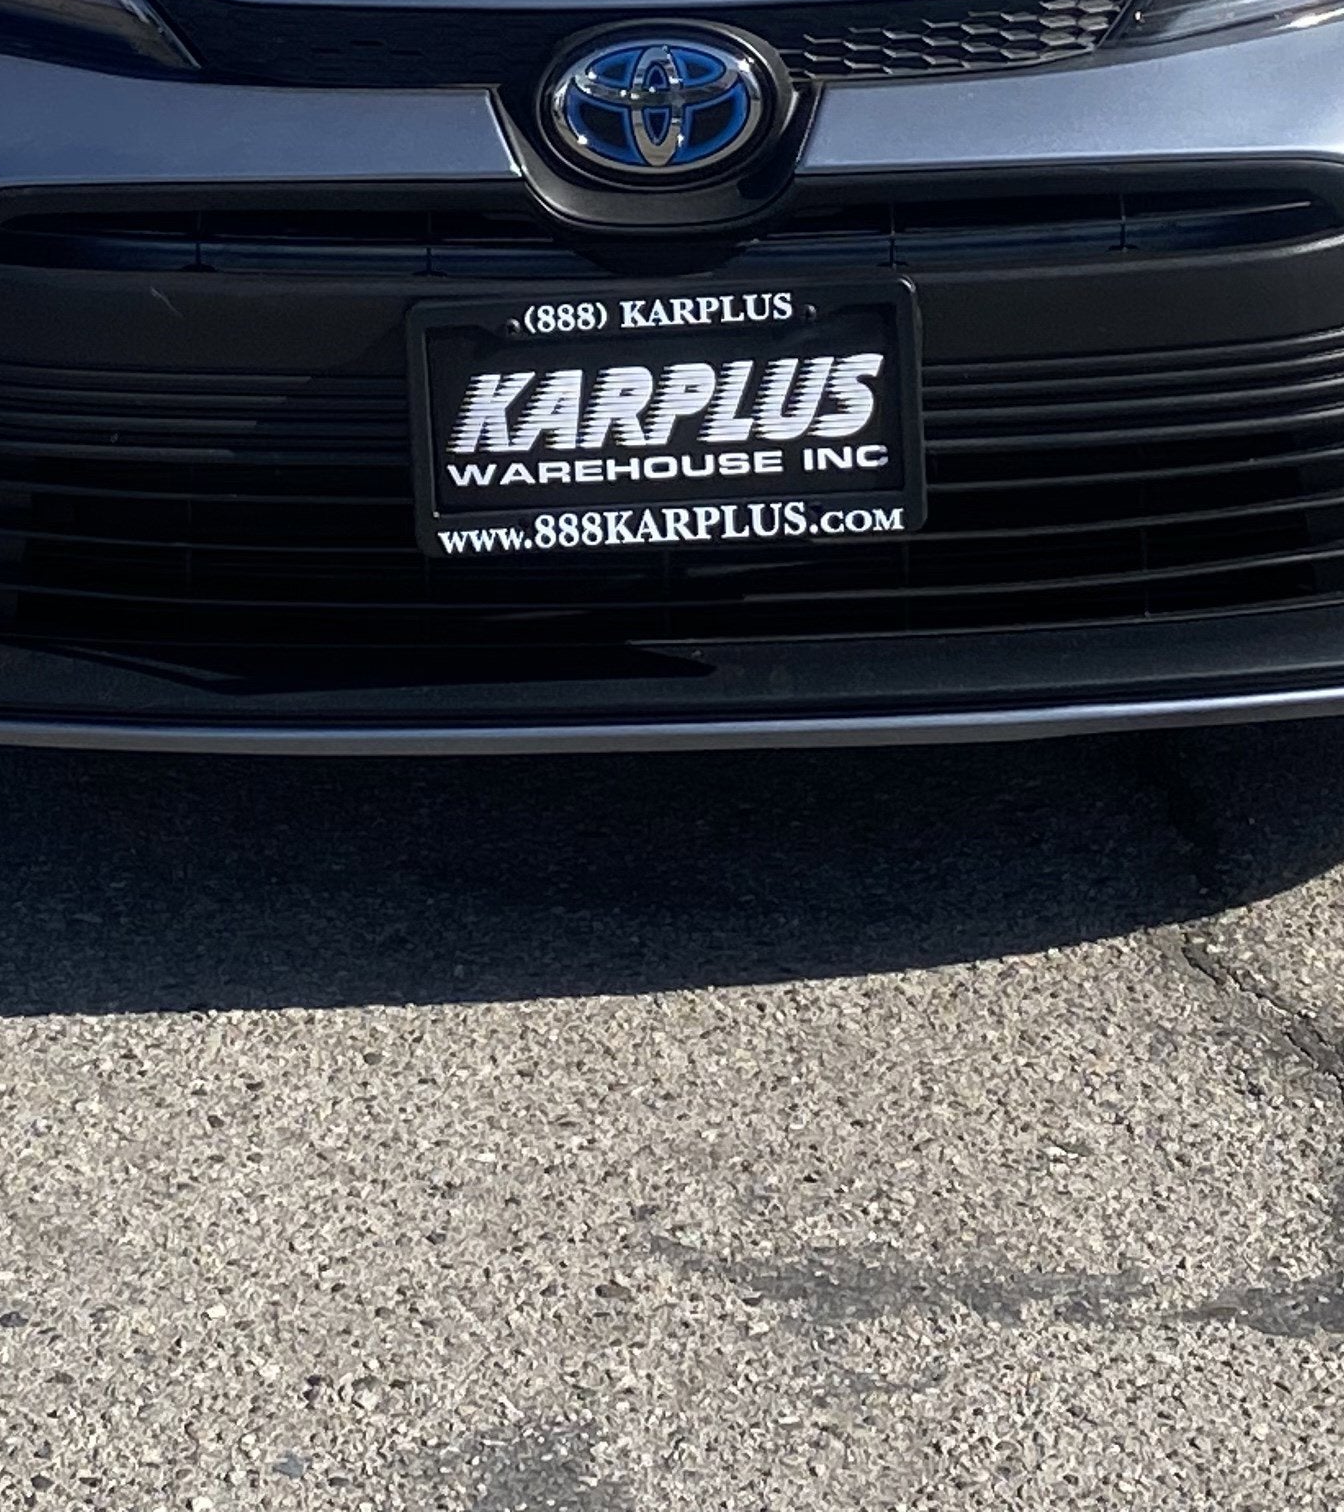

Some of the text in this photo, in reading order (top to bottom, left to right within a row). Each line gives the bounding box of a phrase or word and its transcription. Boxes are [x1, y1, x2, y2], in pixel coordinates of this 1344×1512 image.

[523, 292, 794, 334] (888) KARPLUS
[444, 352, 885, 455] KARPLUS
[446, 443, 889, 487] WAREHOUSE INC
